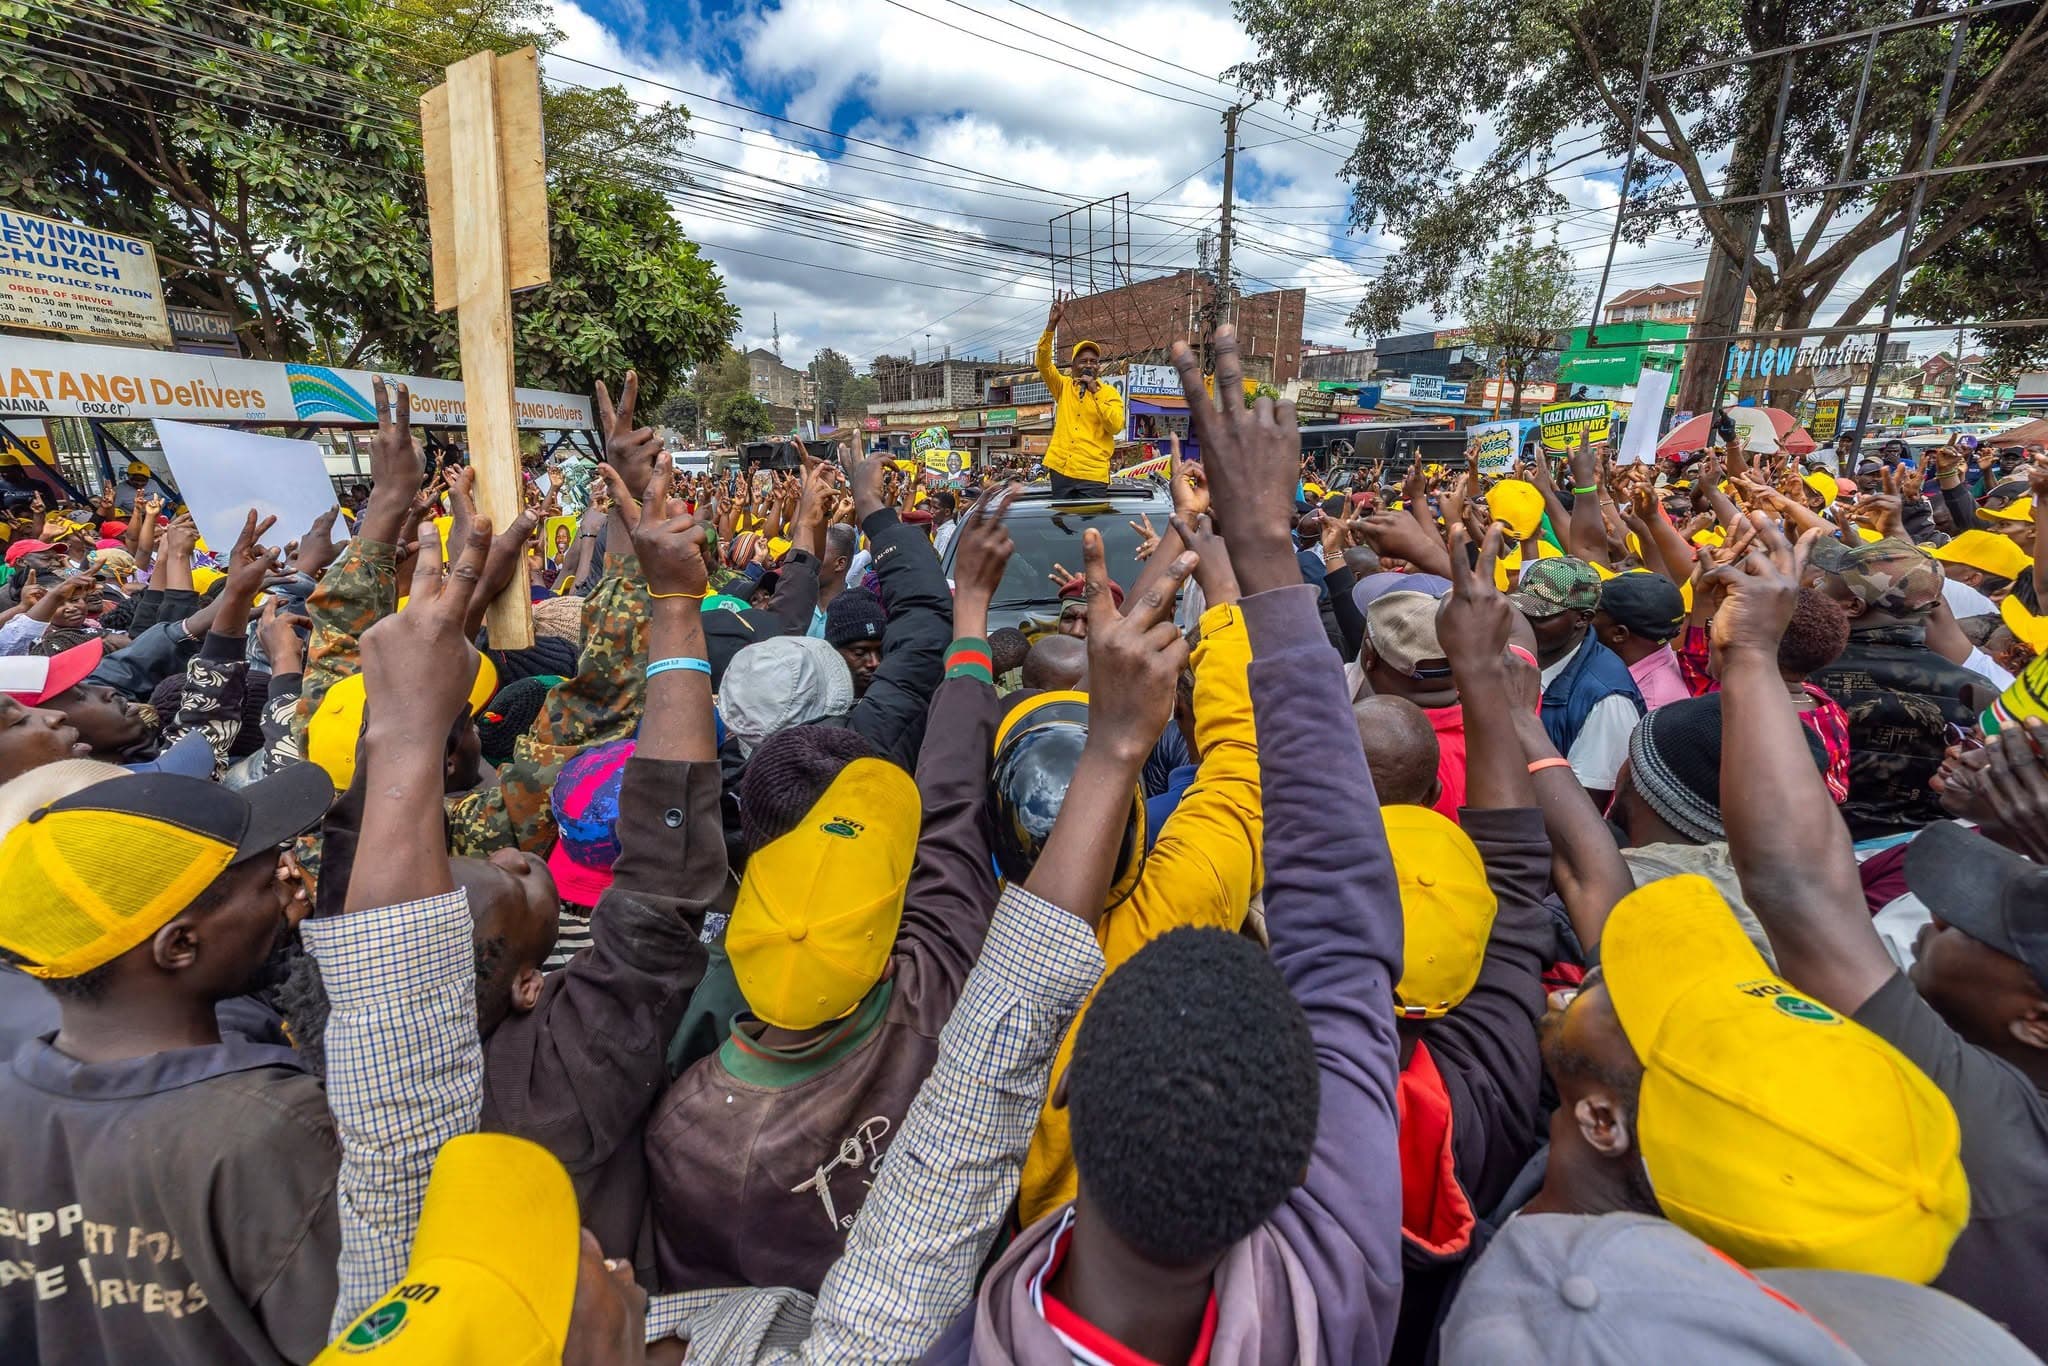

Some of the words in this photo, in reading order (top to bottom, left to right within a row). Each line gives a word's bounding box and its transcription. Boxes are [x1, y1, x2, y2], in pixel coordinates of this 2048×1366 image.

[0, 230, 116, 264] EVIVAL
[8, 283, 49, 296] ORDER
[52, 290, 68, 299] OF
[71, 293, 114, 307] SERVICE
[95, 282, 153, 300] STATION
[58, 301, 72, 309] am
[70, 313, 84, 321] pm
[65, 324, 79, 332] pm
[1132, 386, 1155, 394] BEAUTY
[1161, 387, 1185, 395] COSMET
[1415, 377, 1439, 389] REMIX
[149, 378, 266, 409] Delivers
[1410, 388, 1442, 399] HARDWARE
[410, 393, 467, 415] Govern
[513, 401, 546, 419] TANGI
[547, 403, 584, 421] Delivers
[1543, 410, 1563, 424] KAZI
[1564, 403, 1606, 420] KWANZA
[1544, 424, 1565, 438] SIASA
[0, 1203, 117, 1256] SUPPRT
